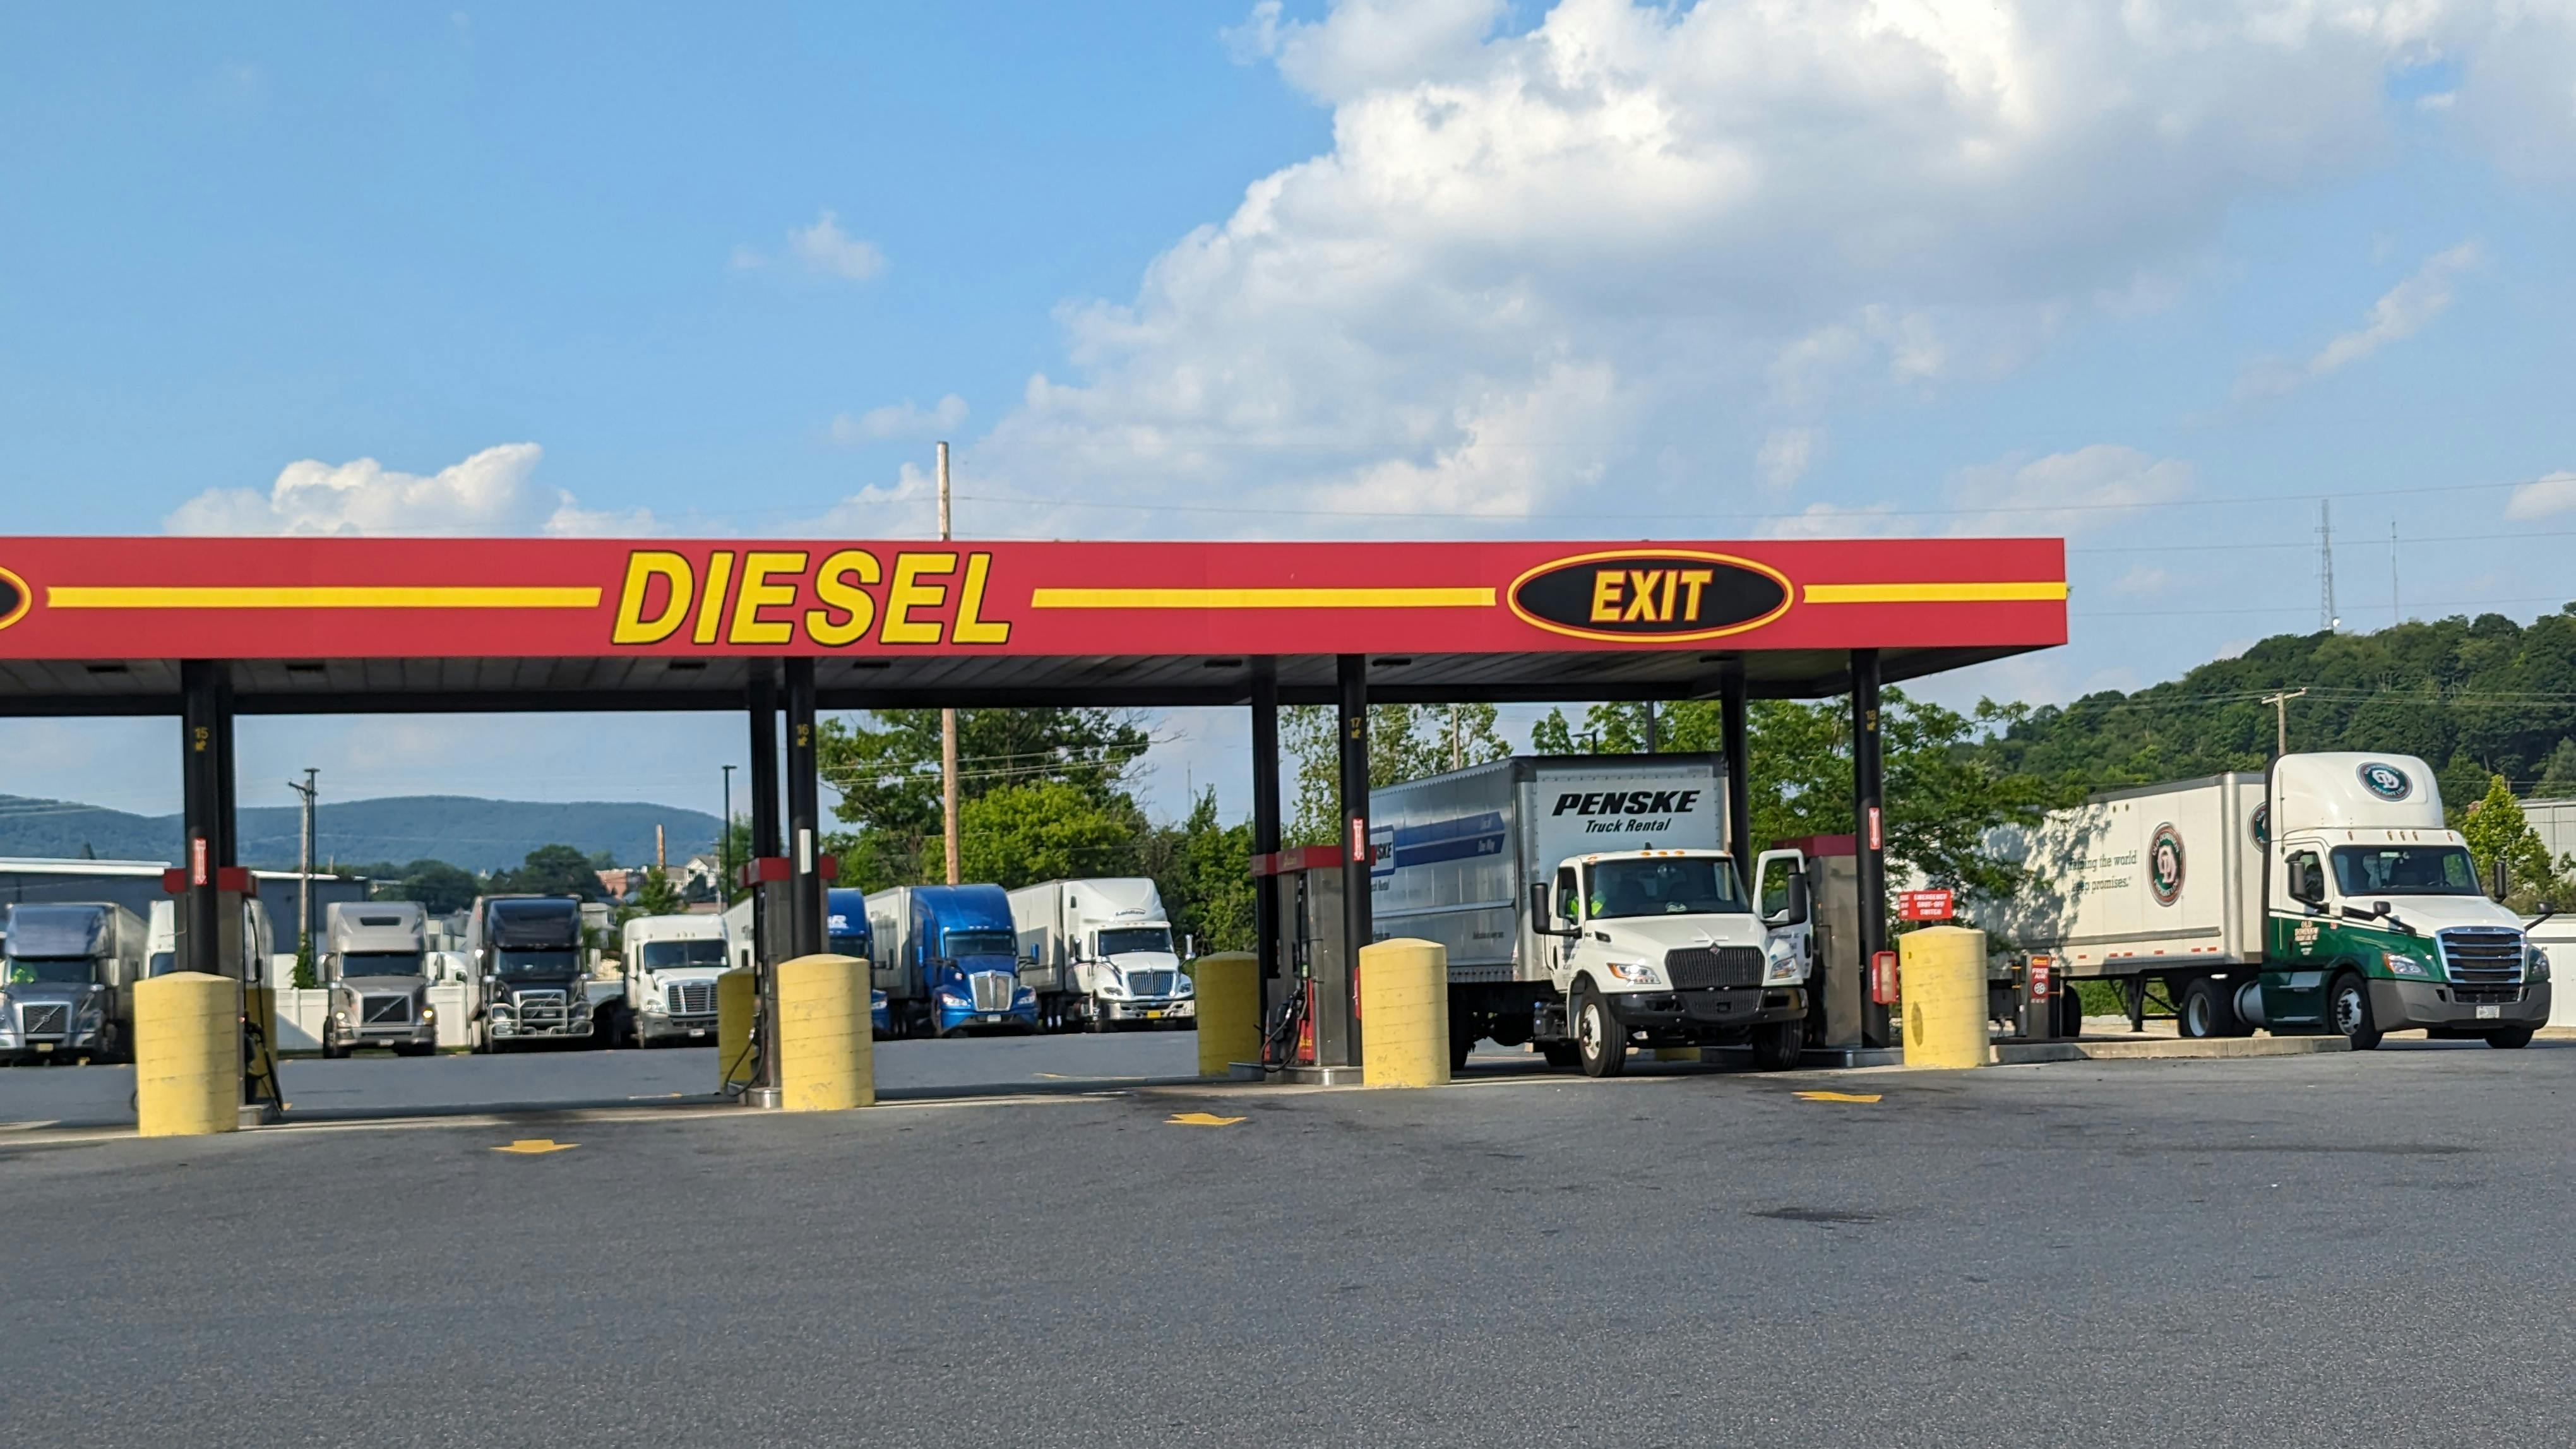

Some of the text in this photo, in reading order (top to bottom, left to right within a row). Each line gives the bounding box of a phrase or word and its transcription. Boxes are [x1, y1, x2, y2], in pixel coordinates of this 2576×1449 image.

[611, 550, 1011, 647] DIESEL
[1590, 568, 1714, 623] EXIT
[1350, 717, 1362, 728] 17
[195, 727, 208, 739] 15
[1552, 790, 1701, 817] PENSKE
[1585, 818, 1672, 833] Truck Rental
[2099, 854, 2112, 868] the
[2113, 850, 2137, 866] world
